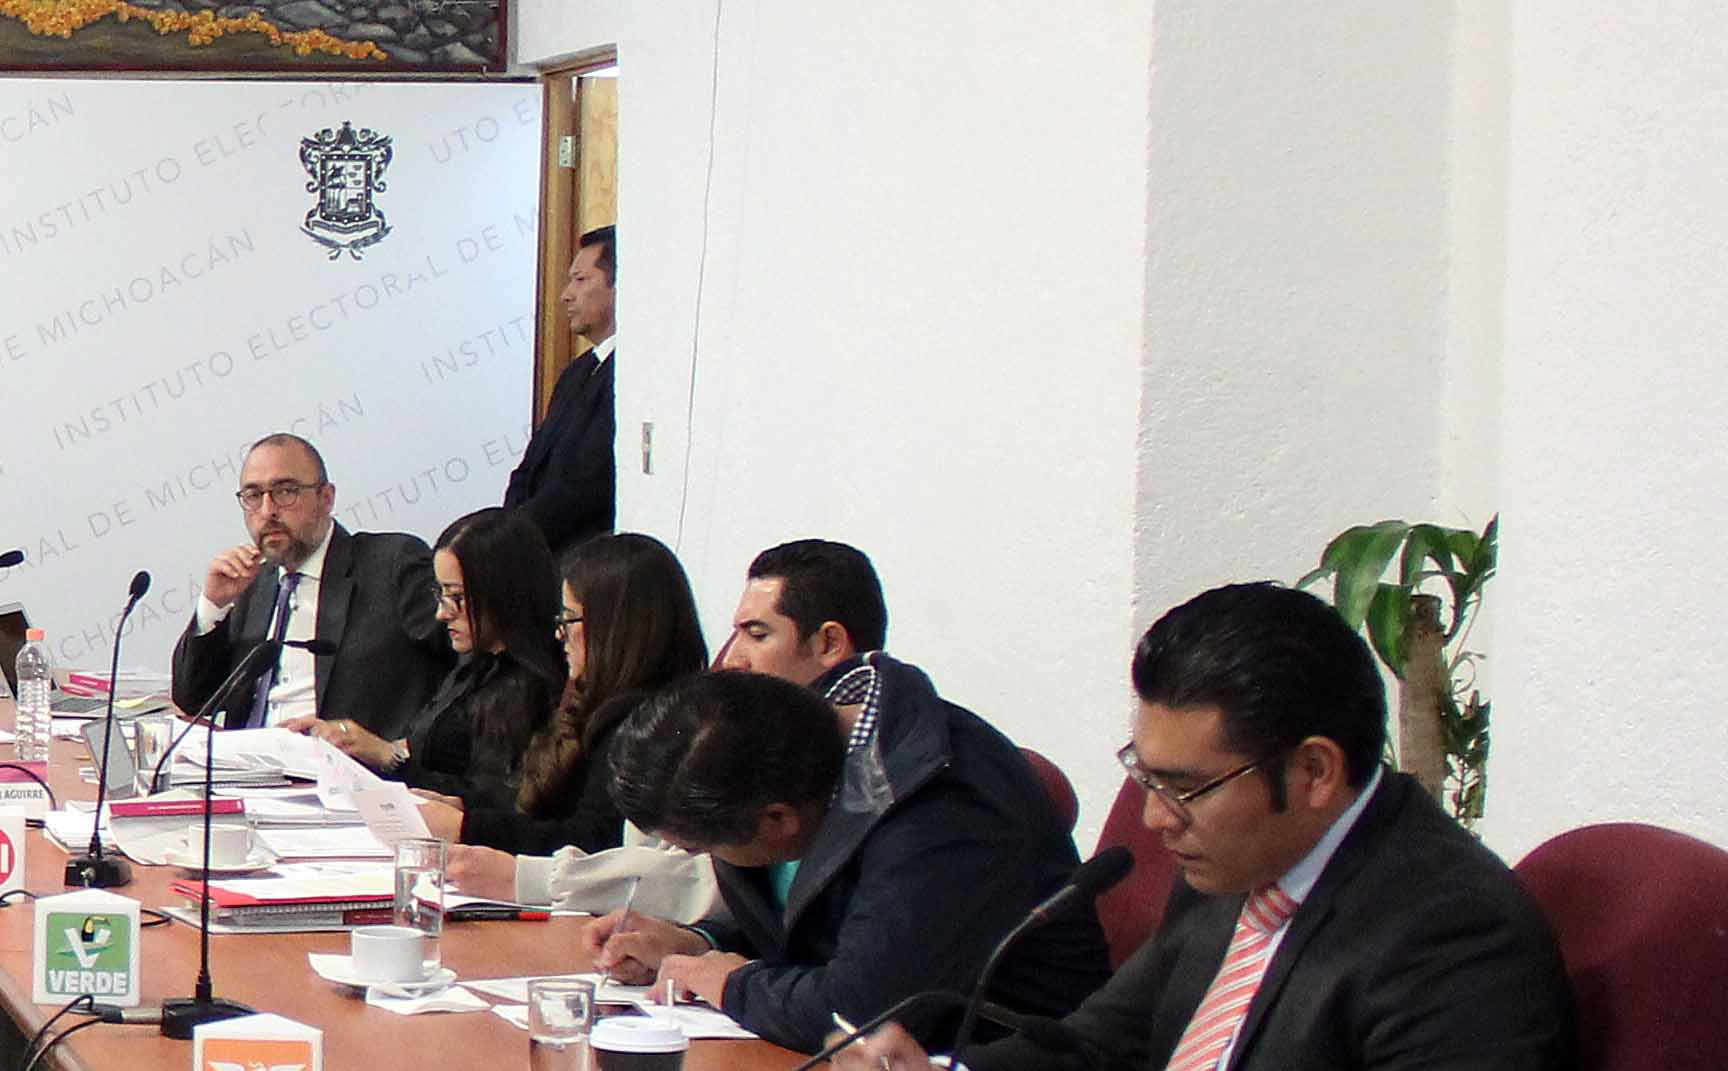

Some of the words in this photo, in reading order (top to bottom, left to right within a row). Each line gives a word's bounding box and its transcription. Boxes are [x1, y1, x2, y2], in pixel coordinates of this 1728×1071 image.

[0, 157, 182, 255] INSTITUTO
[36, 227, 256, 346] MICHOACÁN
[52, 350, 234, 450] INSTITUTO
[87, 498, 136, 538] DE
[4, 789, 45, 799] AGUIRRE
[48, 969, 128, 994] VERDE
